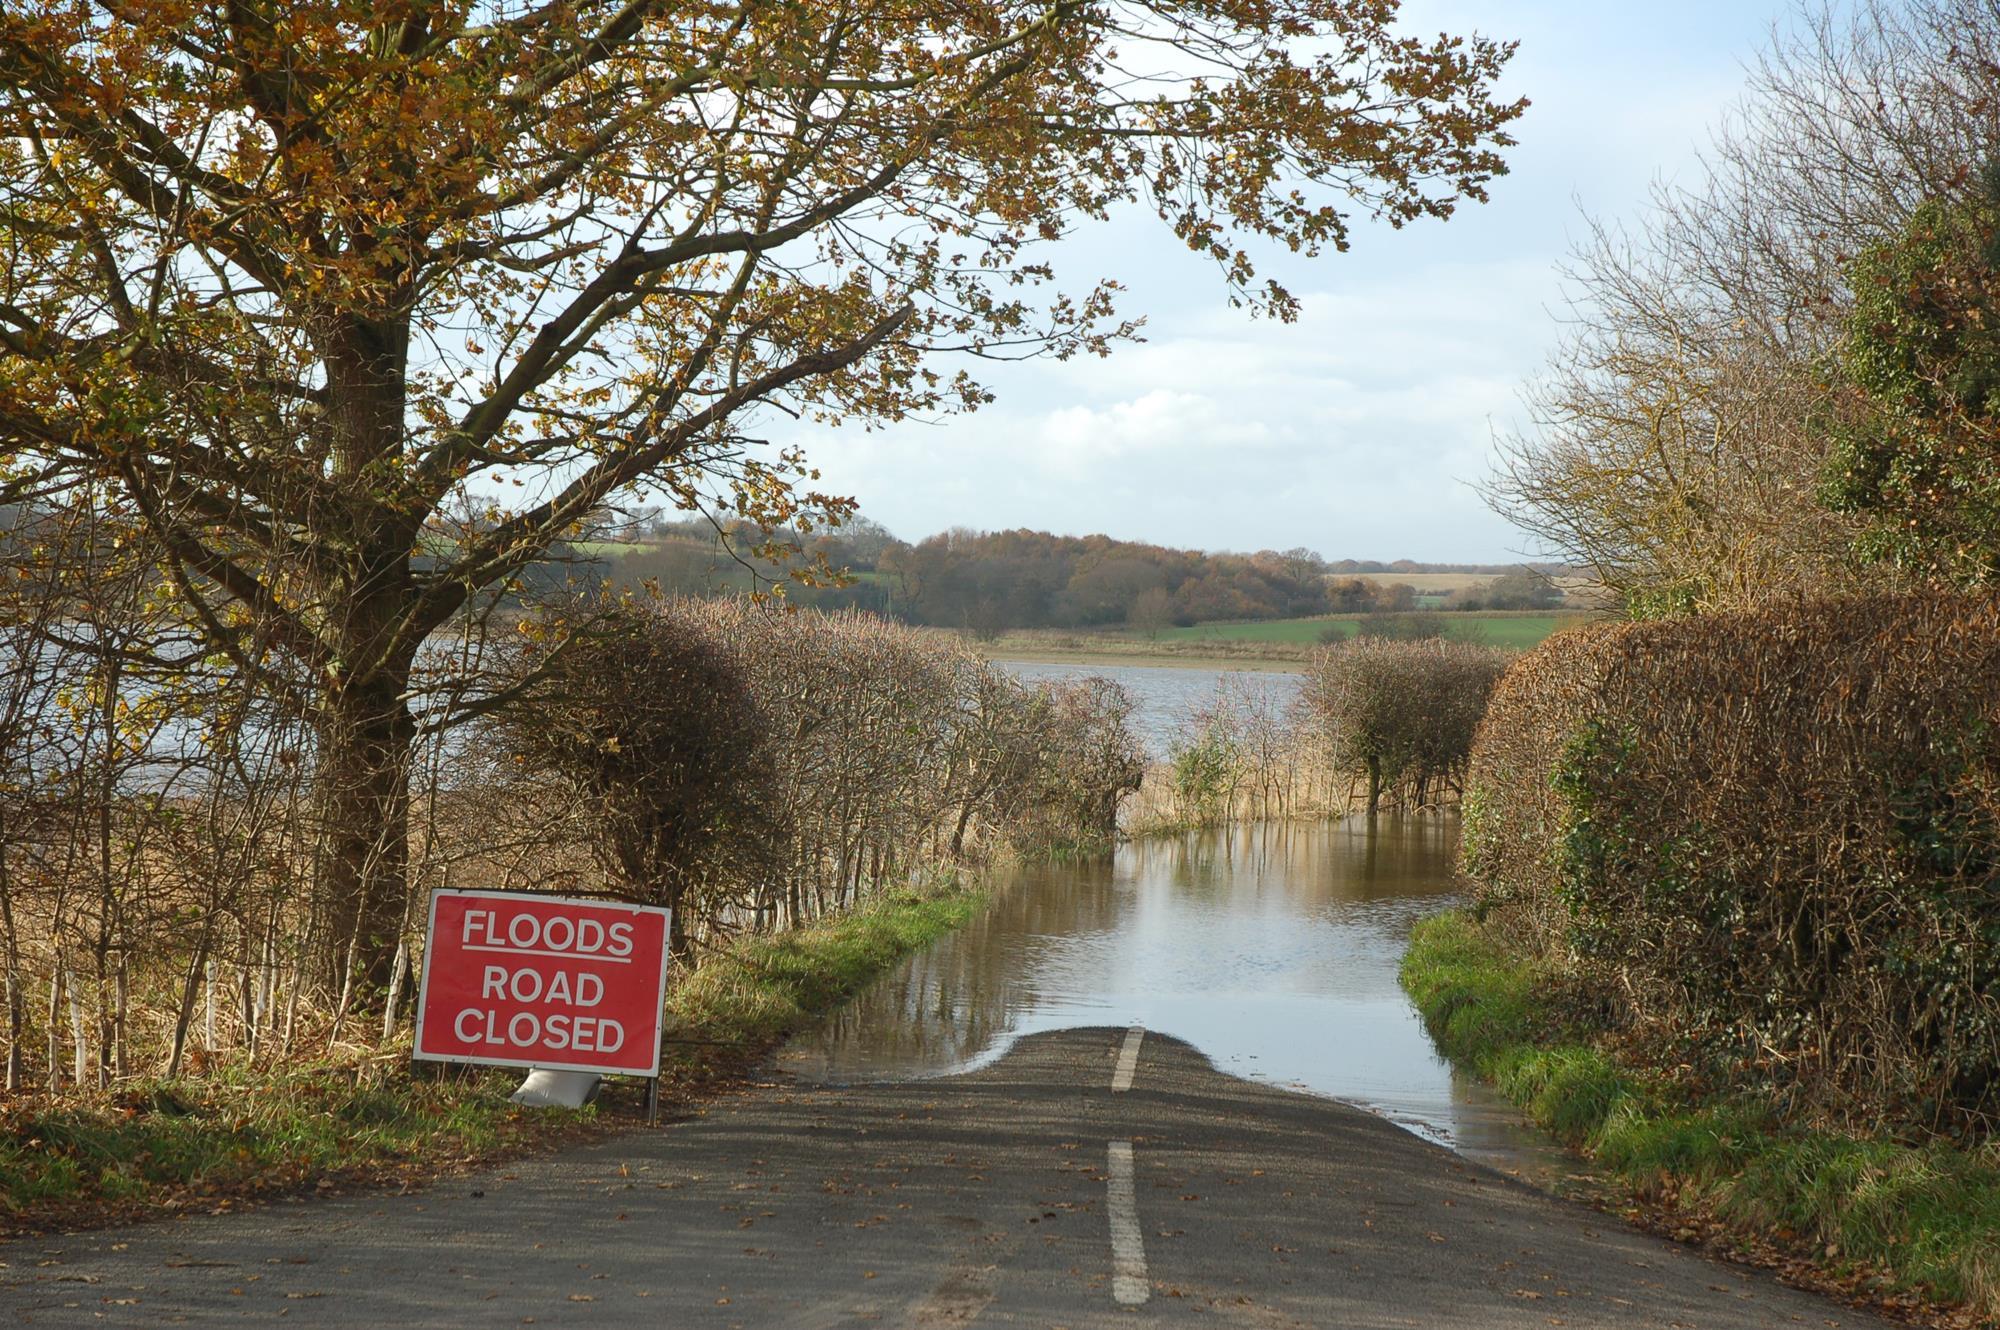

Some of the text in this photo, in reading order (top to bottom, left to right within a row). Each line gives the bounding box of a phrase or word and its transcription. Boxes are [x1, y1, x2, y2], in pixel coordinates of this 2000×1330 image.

[462, 910, 634, 956] FLOODS
[482, 965, 604, 1007] ROAD
[454, 1008, 625, 1053] CLOSED
